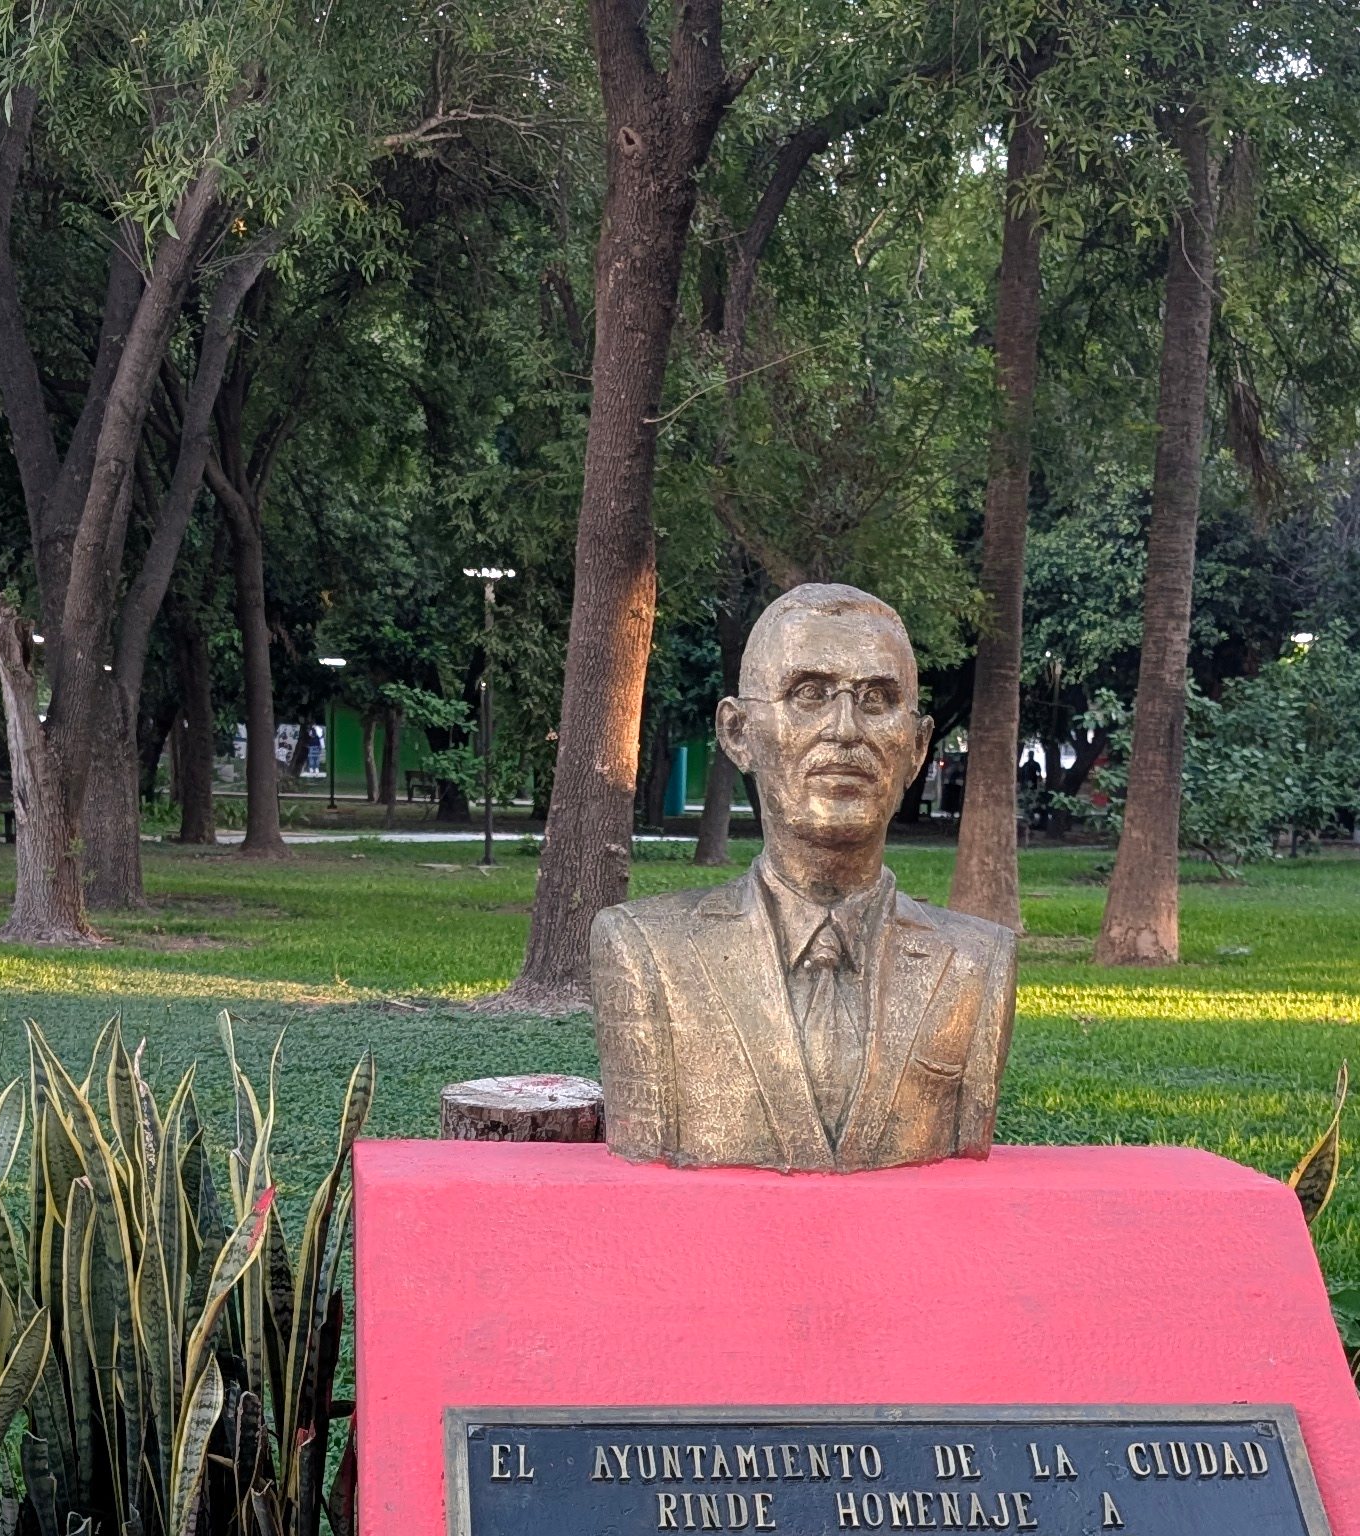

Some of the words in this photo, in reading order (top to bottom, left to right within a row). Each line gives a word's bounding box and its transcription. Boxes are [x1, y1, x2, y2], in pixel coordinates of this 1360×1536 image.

[491, 1444, 534, 1482] EL
[591, 1443, 883, 1482] AYUNTAMIENTO
[935, 1443, 981, 1479] DE
[1028, 1442, 1078, 1480] LA
[1126, 1441, 1269, 1479] CIUDAD
[656, 1492, 777, 1530] RINDE
[835, 1490, 1038, 1530] HOMENAJE
[1100, 1491, 1125, 1528] A
